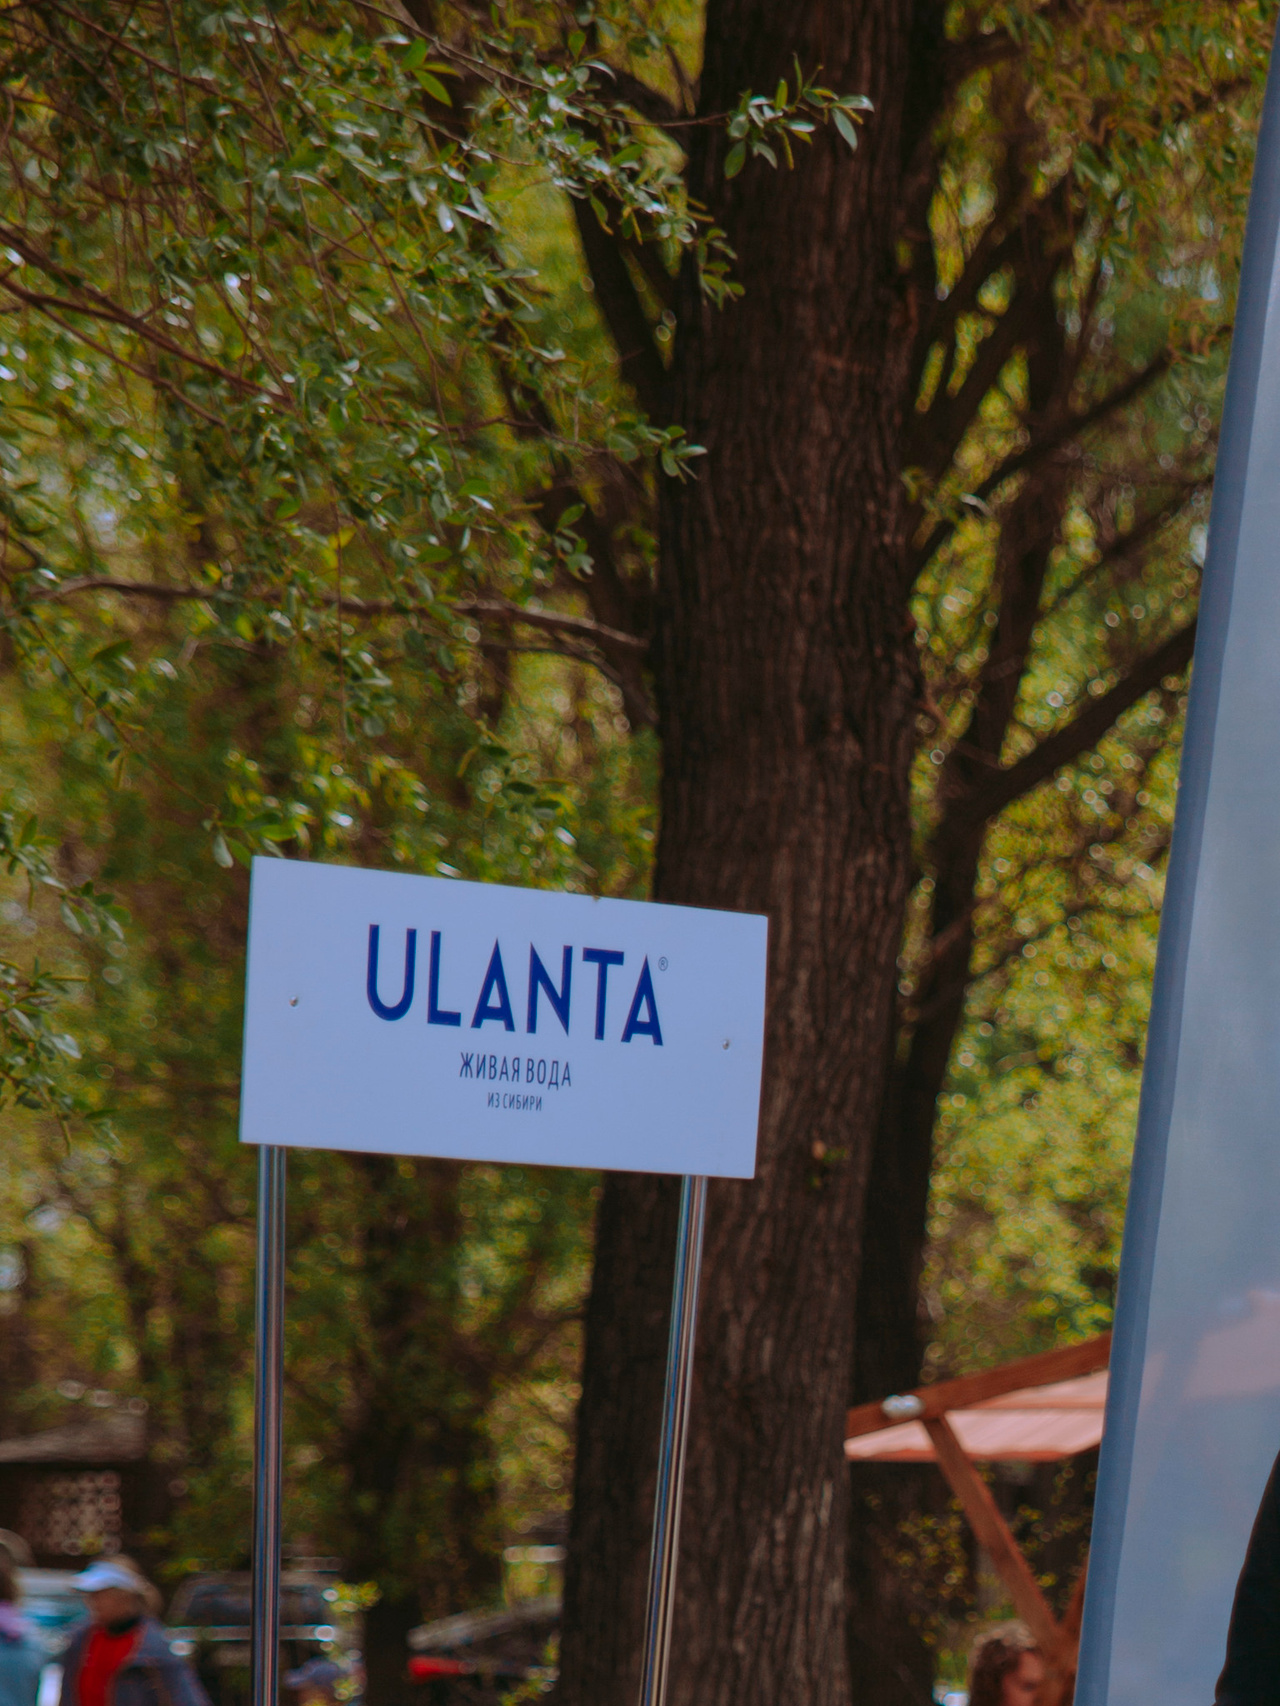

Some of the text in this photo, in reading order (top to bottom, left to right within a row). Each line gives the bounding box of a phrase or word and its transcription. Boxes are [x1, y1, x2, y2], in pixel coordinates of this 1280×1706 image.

[459, 1052, 571, 1091] ЖИВАЯ ВОДА
[487, 1092, 542, 1111] ИЗ СИБИРИ
